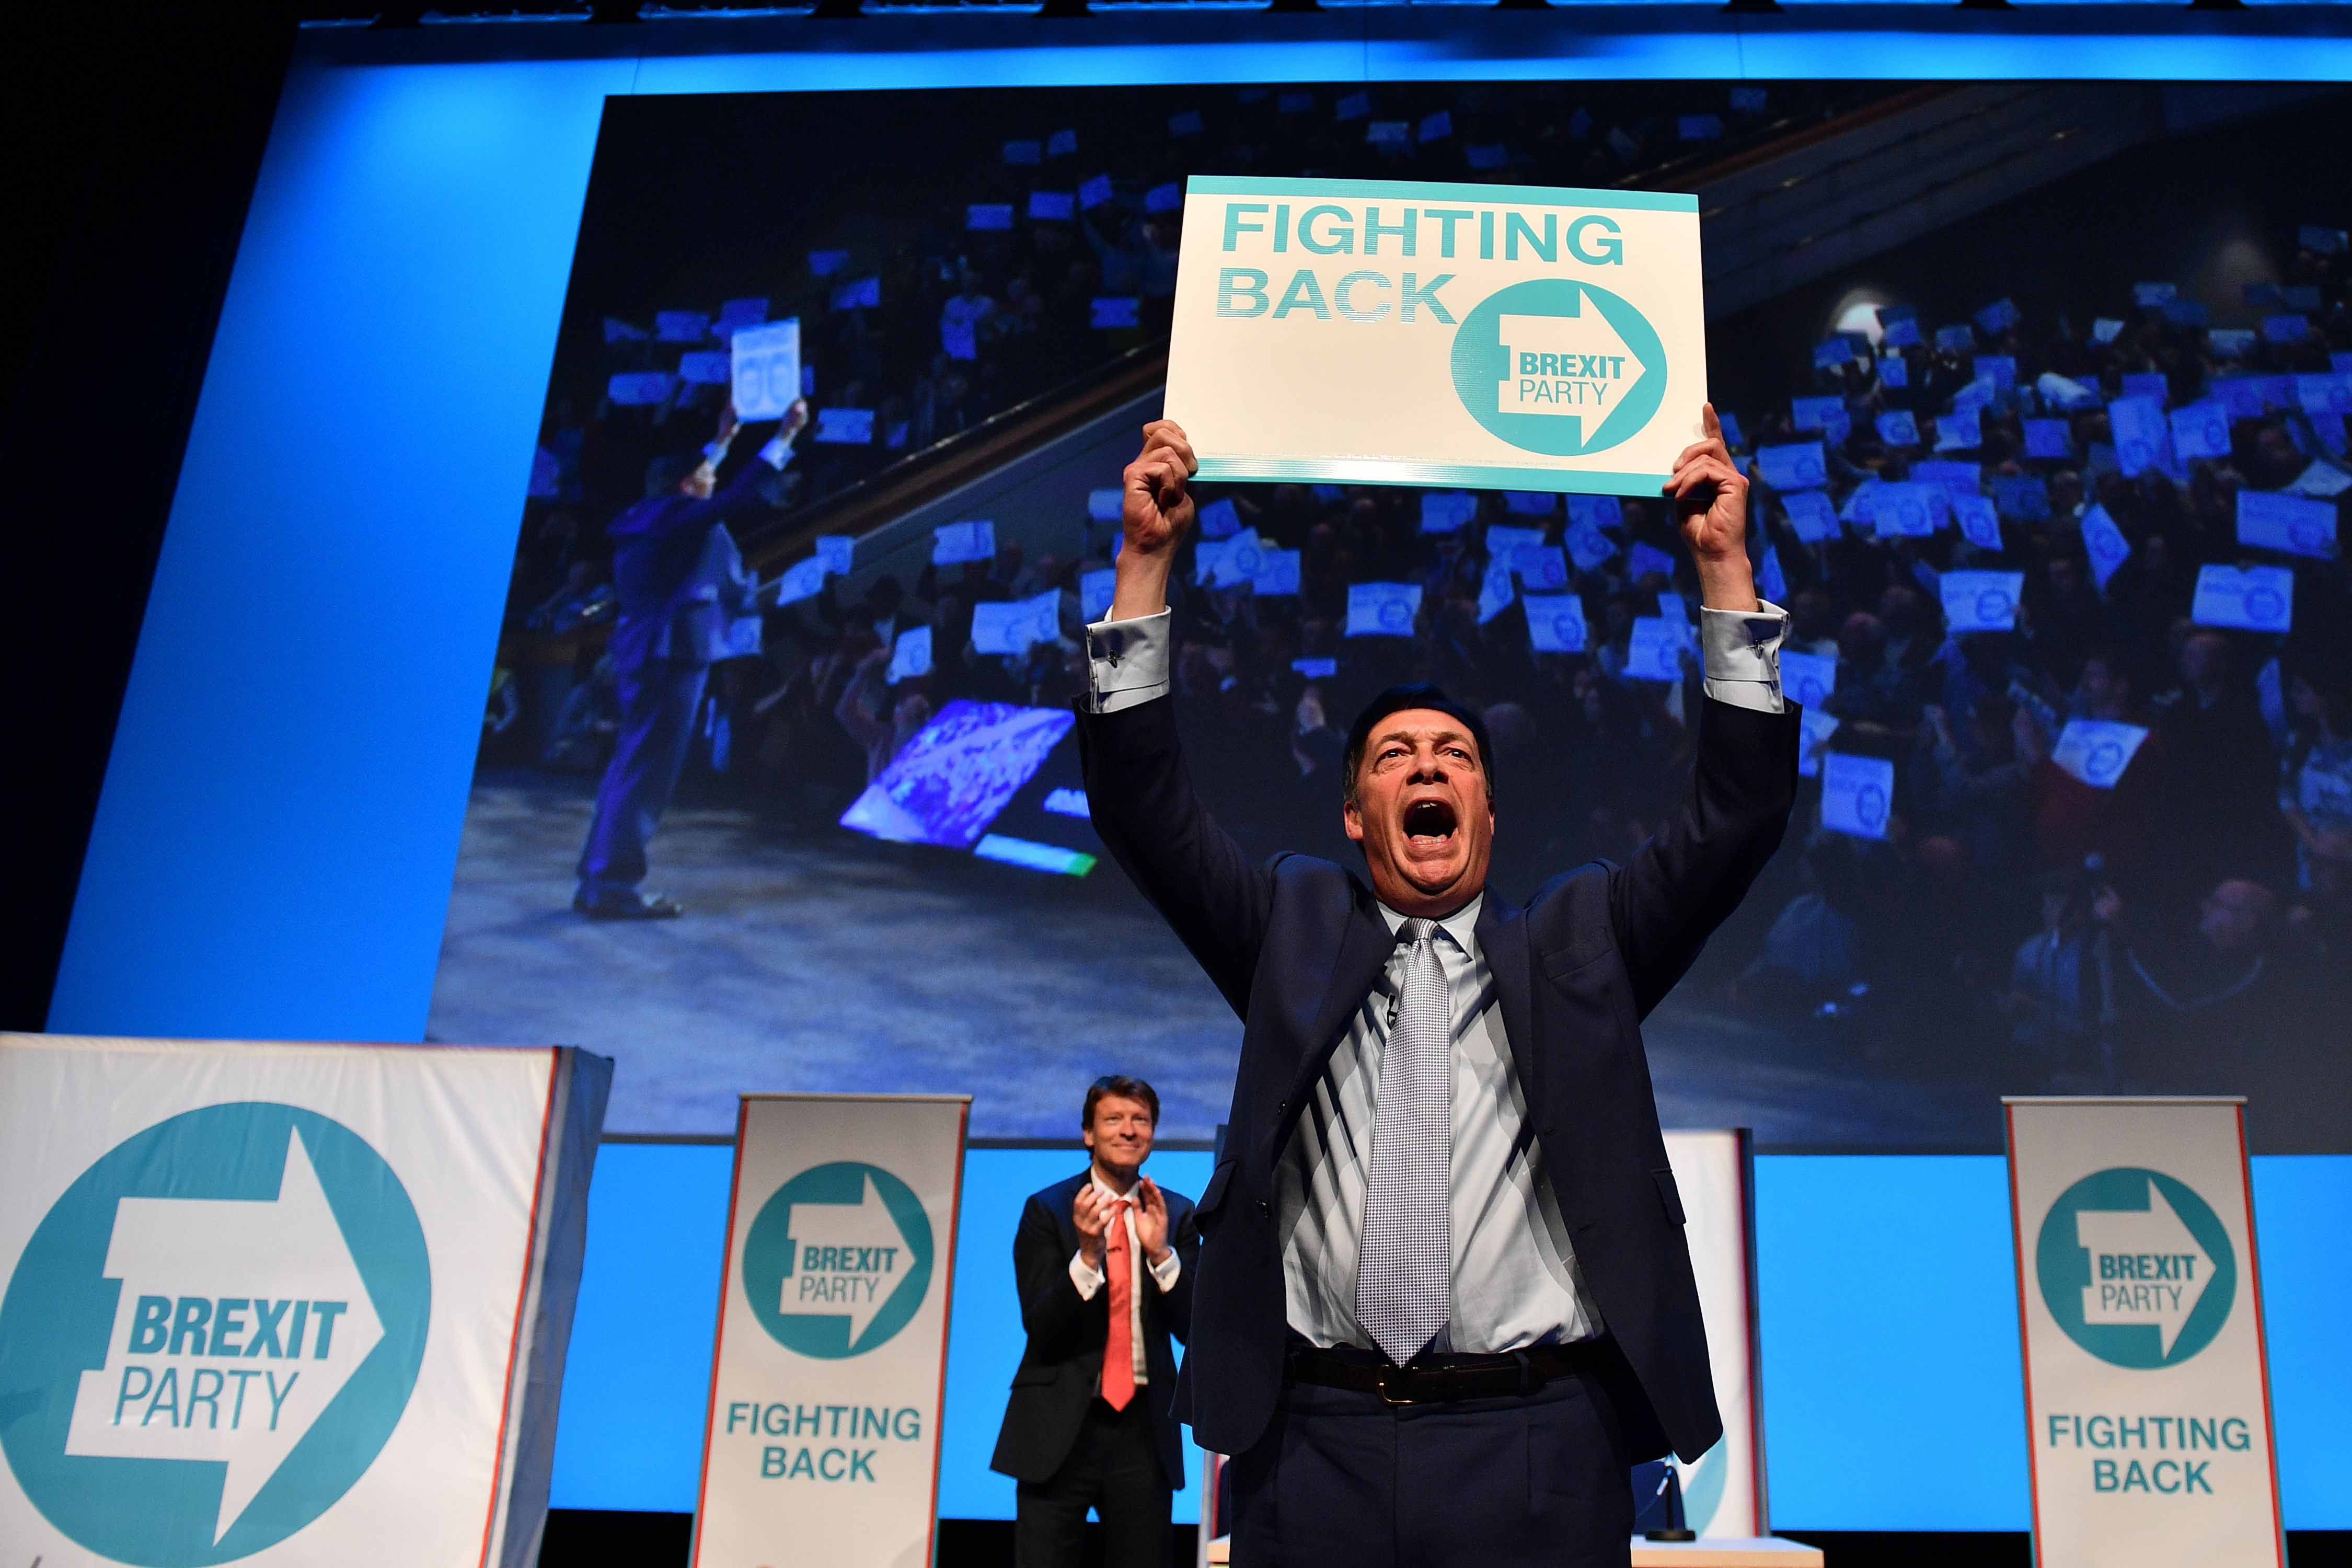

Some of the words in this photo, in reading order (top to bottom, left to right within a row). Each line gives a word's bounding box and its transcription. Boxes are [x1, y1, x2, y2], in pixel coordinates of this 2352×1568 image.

[1221, 203, 1623, 266] FIGHTING
[1216, 267, 1458, 325] BACK
[1519, 352, 1625, 379] BREXIT
[1519, 380, 1608, 405] PARTY
[802, 1247, 898, 1273] BREXIT
[2100, 1254, 2196, 1281] BREXIT
[799, 1276, 881, 1303] PARTY
[2101, 1284, 2183, 1311] PARTY
[127, 1295, 348, 1359] BREXIT
[112, 1365, 300, 1432] PARTY
[727, 1403, 921, 1440] FIGHTING
[2048, 1414, 2251, 1451] FIGHTING
[761, 1446, 877, 1482] BACK
[2092, 1460, 2213, 1494] BACK
